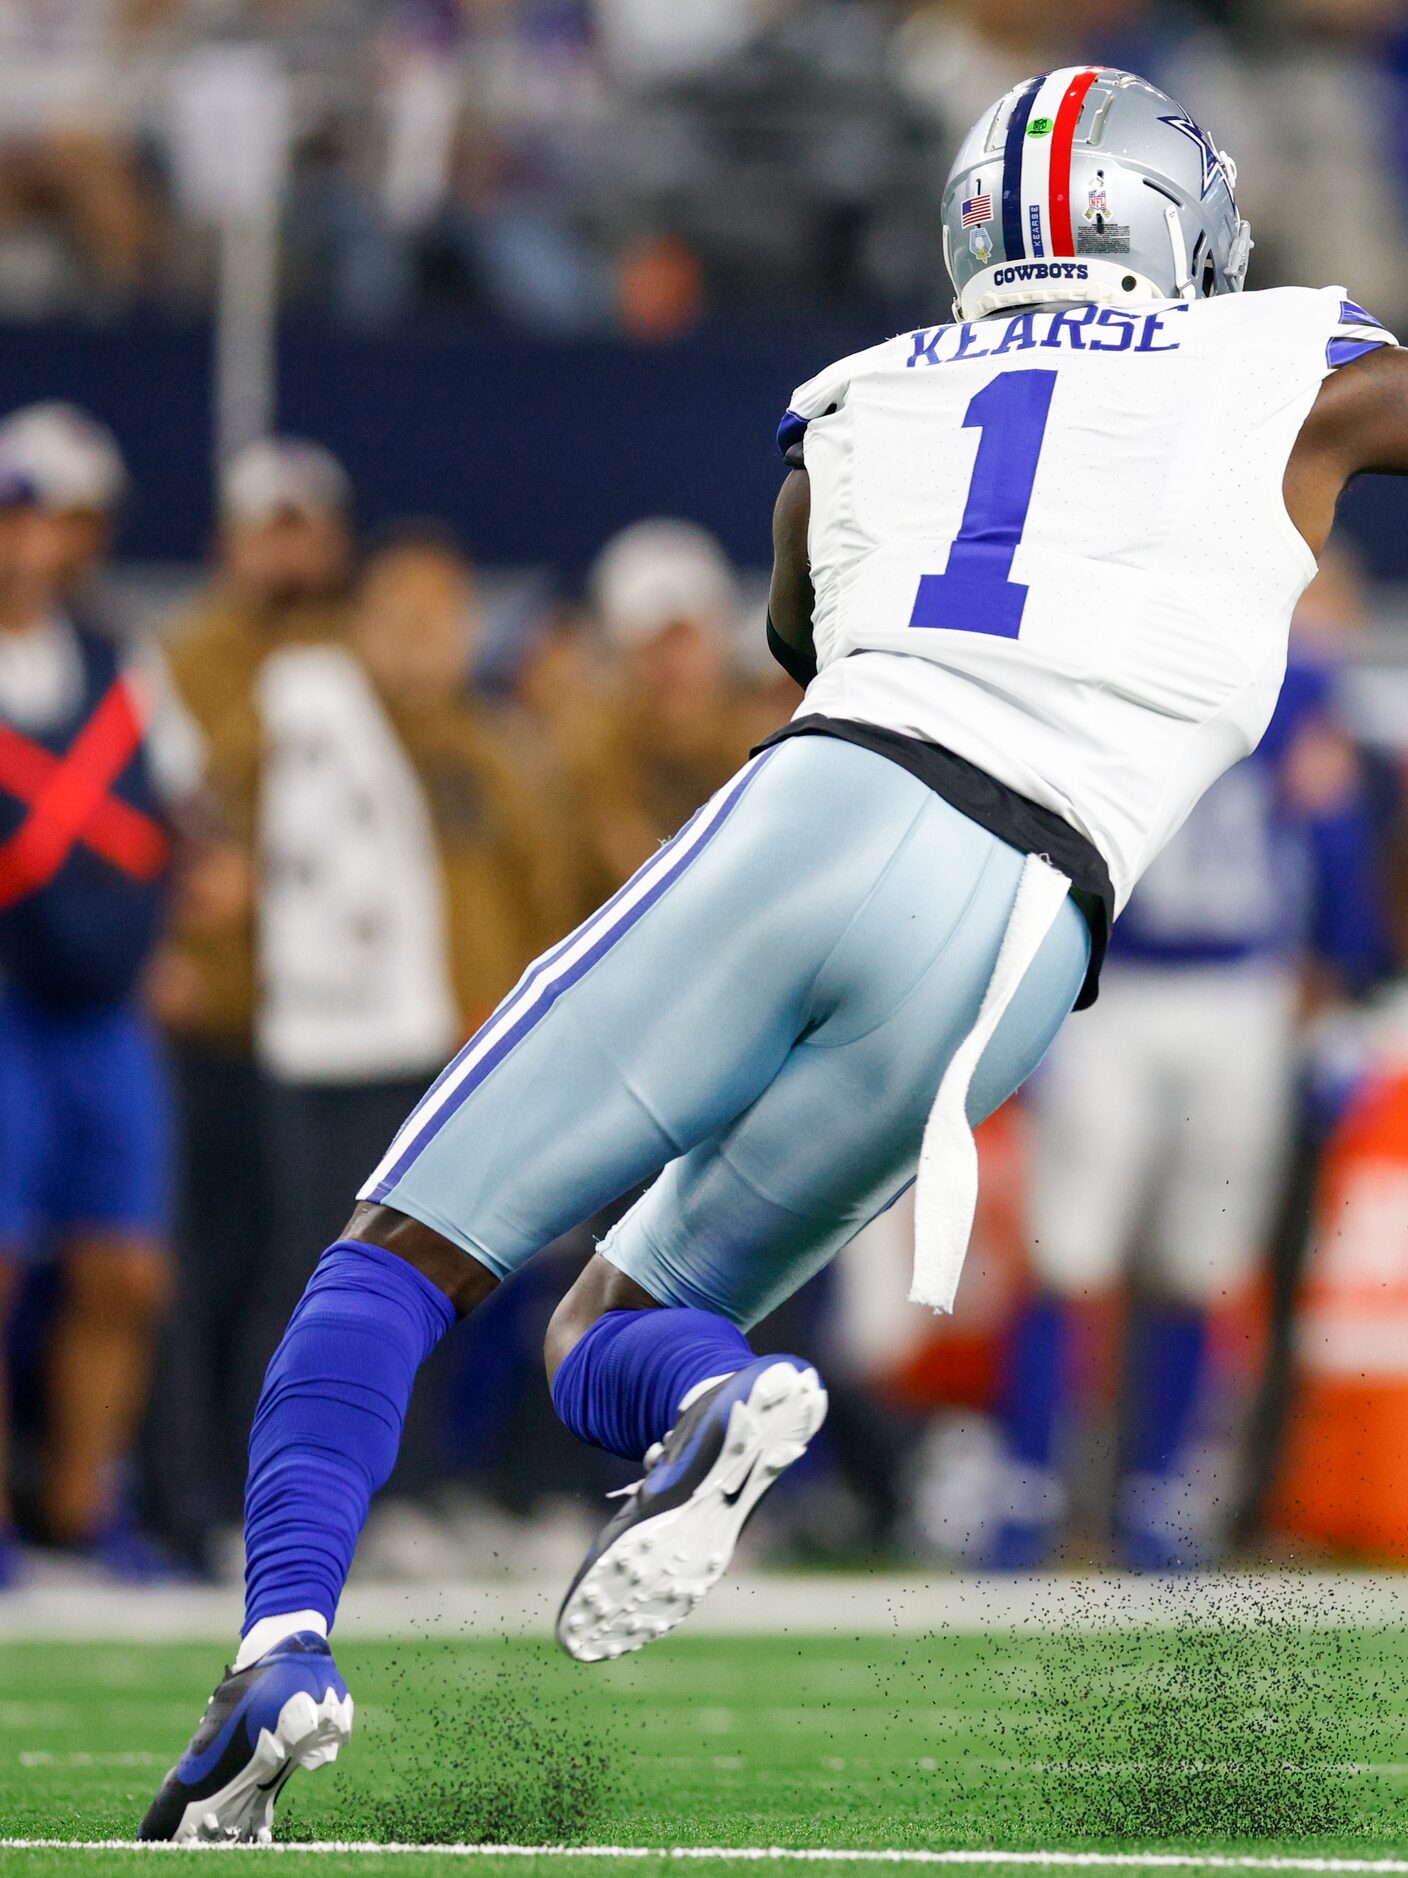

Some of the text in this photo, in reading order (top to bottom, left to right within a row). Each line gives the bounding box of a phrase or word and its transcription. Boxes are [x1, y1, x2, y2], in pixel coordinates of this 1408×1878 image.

[1030, 206, 1041, 247] KEARSE
[994, 263, 1088, 286] COWBOYS
[906, 304, 1190, 368] KEARSE
[908, 369, 1058, 640] 1
